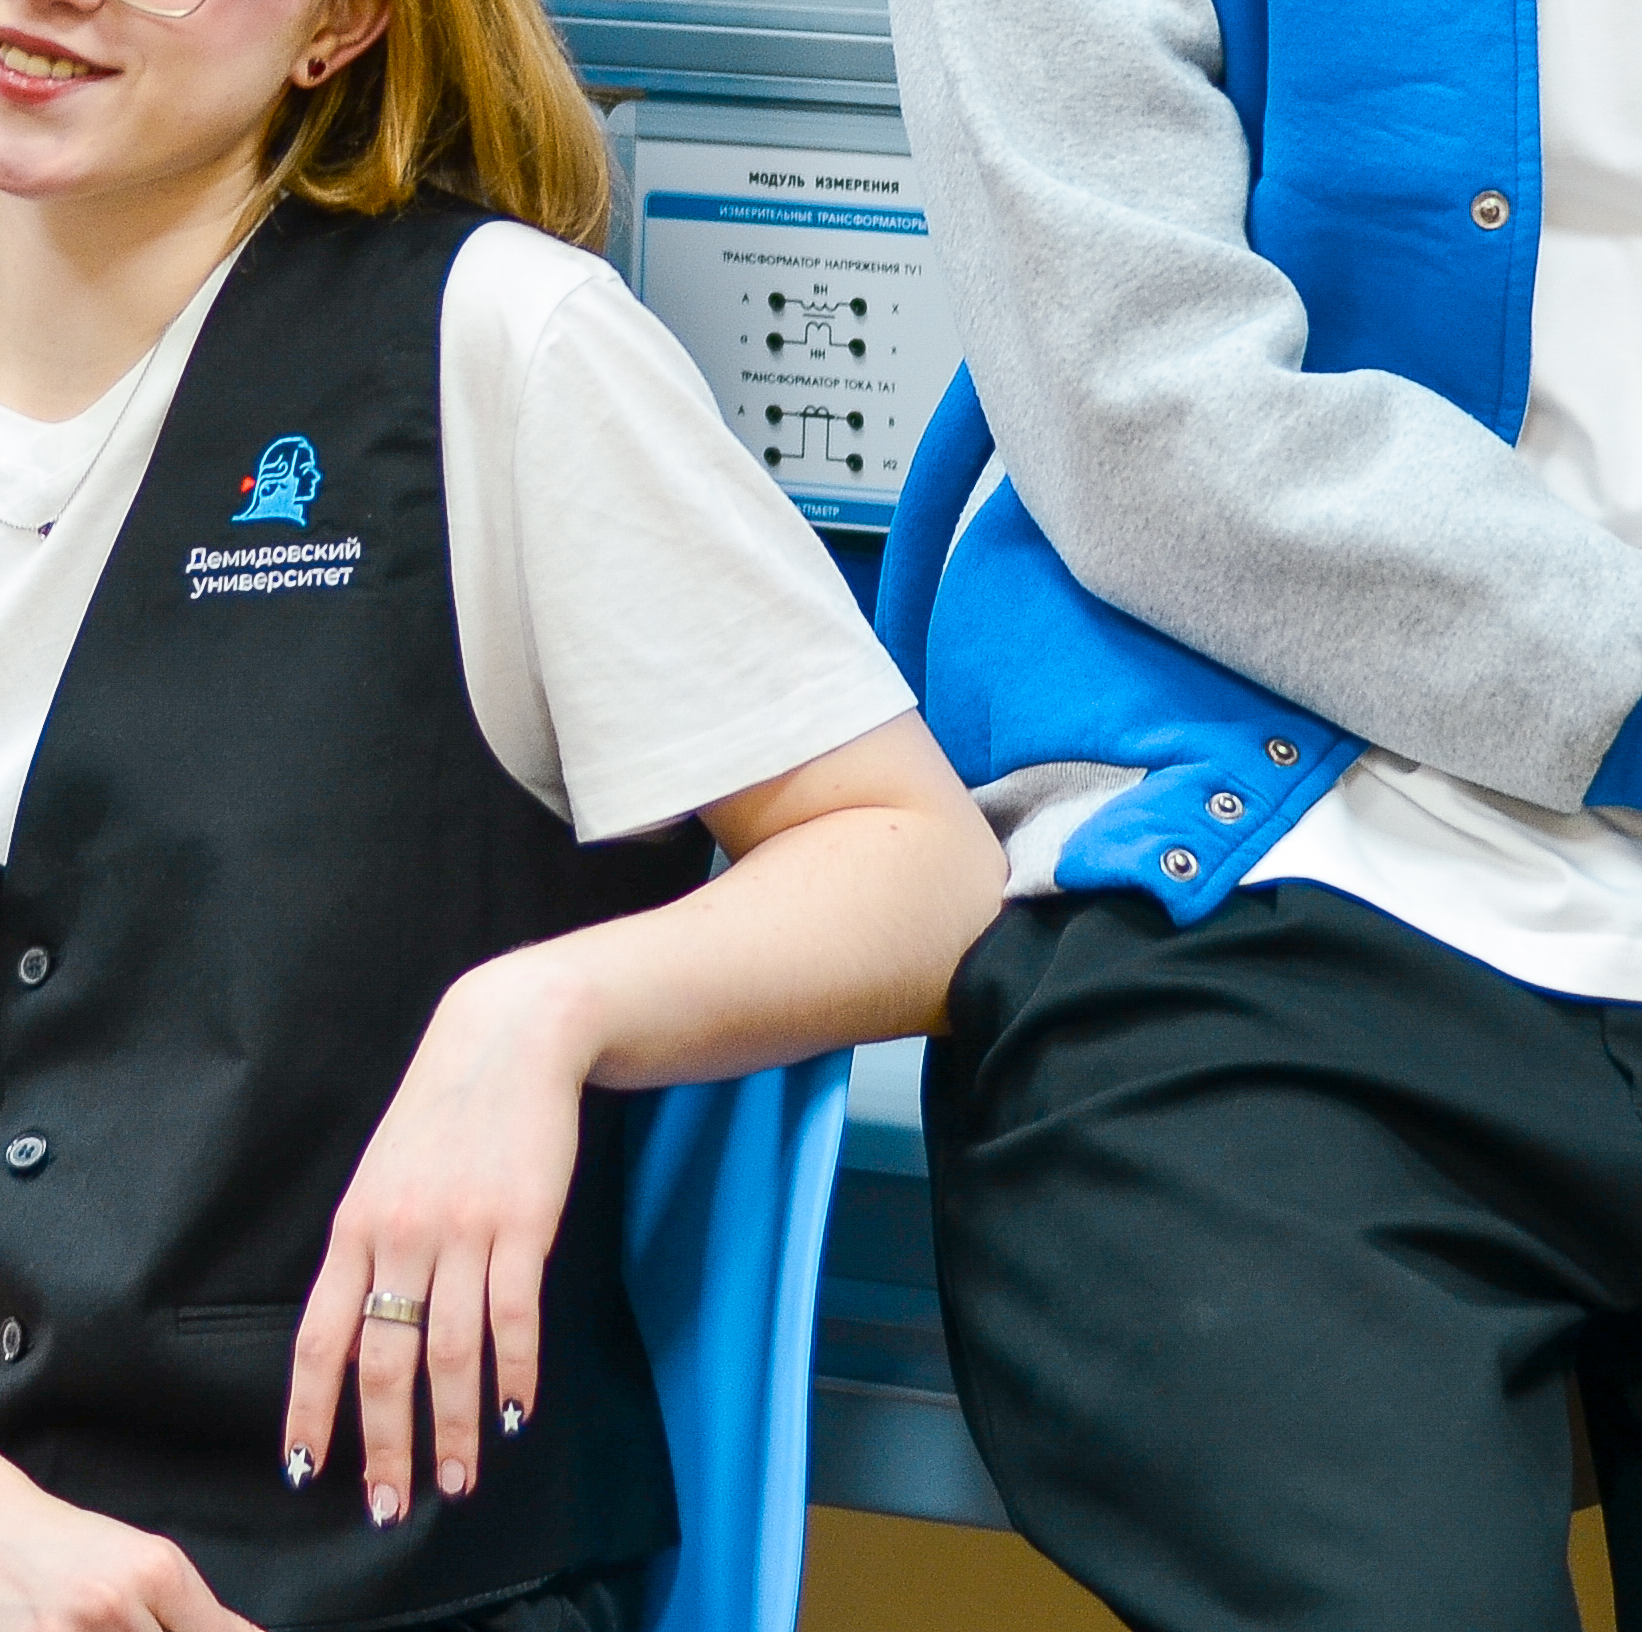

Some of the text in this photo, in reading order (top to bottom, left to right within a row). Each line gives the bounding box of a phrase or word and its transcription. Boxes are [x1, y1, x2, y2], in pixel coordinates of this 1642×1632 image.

[748, 171, 900, 194] МОДУЛЬ ИЗМЕРЕНИЯ
[719, 205, 927, 231] ИЗМЕРИТЕЛЬНЫЕ ТРАНСФОРМАТОРЫ
[722, 251, 821, 268] ТРАНСФОРМАТОР
[824, 259, 900, 274] НАПРЯЖЕНИЯ
[813, 284, 828, 295] ВН
[810, 348, 826, 360] НН
[741, 370, 840, 389] ТРАНСФОРМАТОР
[843, 379, 872, 391] ТОКА
[883, 459, 898, 469] И2
[797, 503, 840, 518] ТТМЕТР
[185, 535, 362, 574] Демидовский
[189, 566, 355, 600] университет
